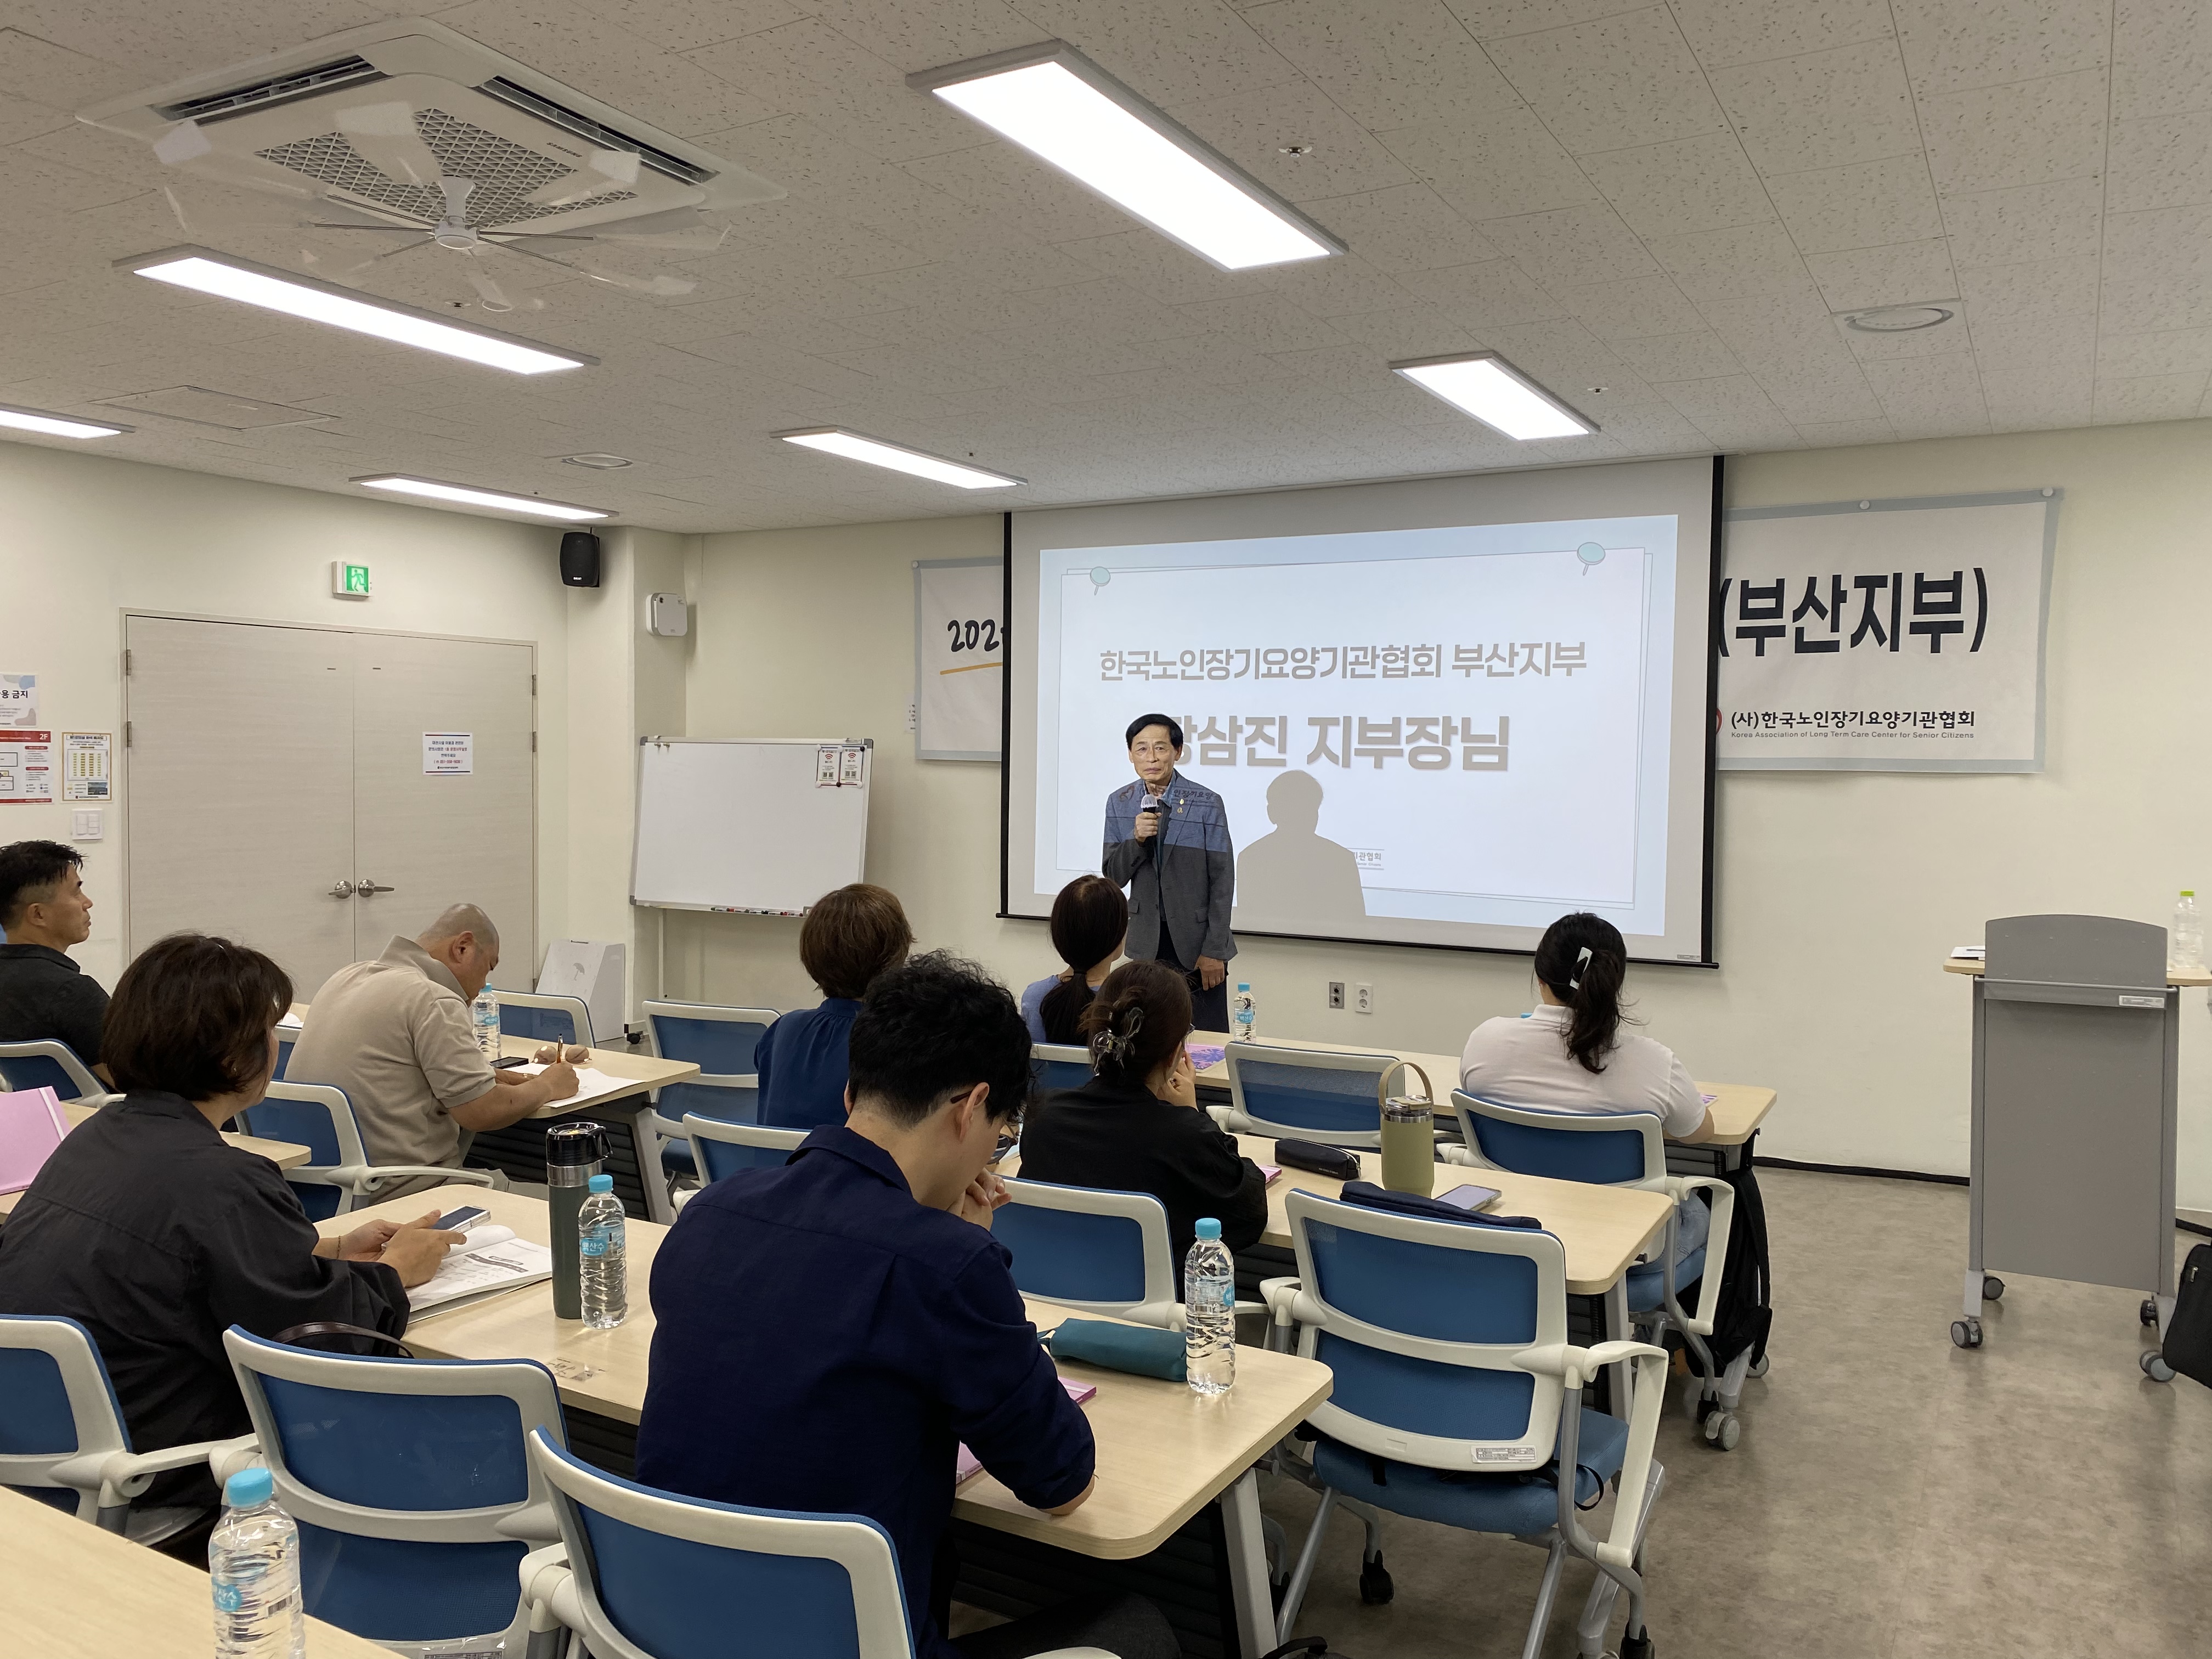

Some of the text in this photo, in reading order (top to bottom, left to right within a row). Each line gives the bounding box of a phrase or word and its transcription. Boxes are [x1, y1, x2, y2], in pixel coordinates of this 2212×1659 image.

[546, 142, 583, 158] SAMSUNG
[1718, 567, 1989, 657] (부산지부)
[947, 619, 1003, 652] 202
[1099, 641, 1587, 682] 한국노인장기요양기관협회 부산지부
[0, 690, 28, 699] 용 금지
[1731, 710, 1975, 730] (사)한국노인장기요양기관협회
[1306, 715, 1510, 772] 지부장님
[1809, 731, 1829, 739] Long
[582, 1242, 605, 1252] 백산수
